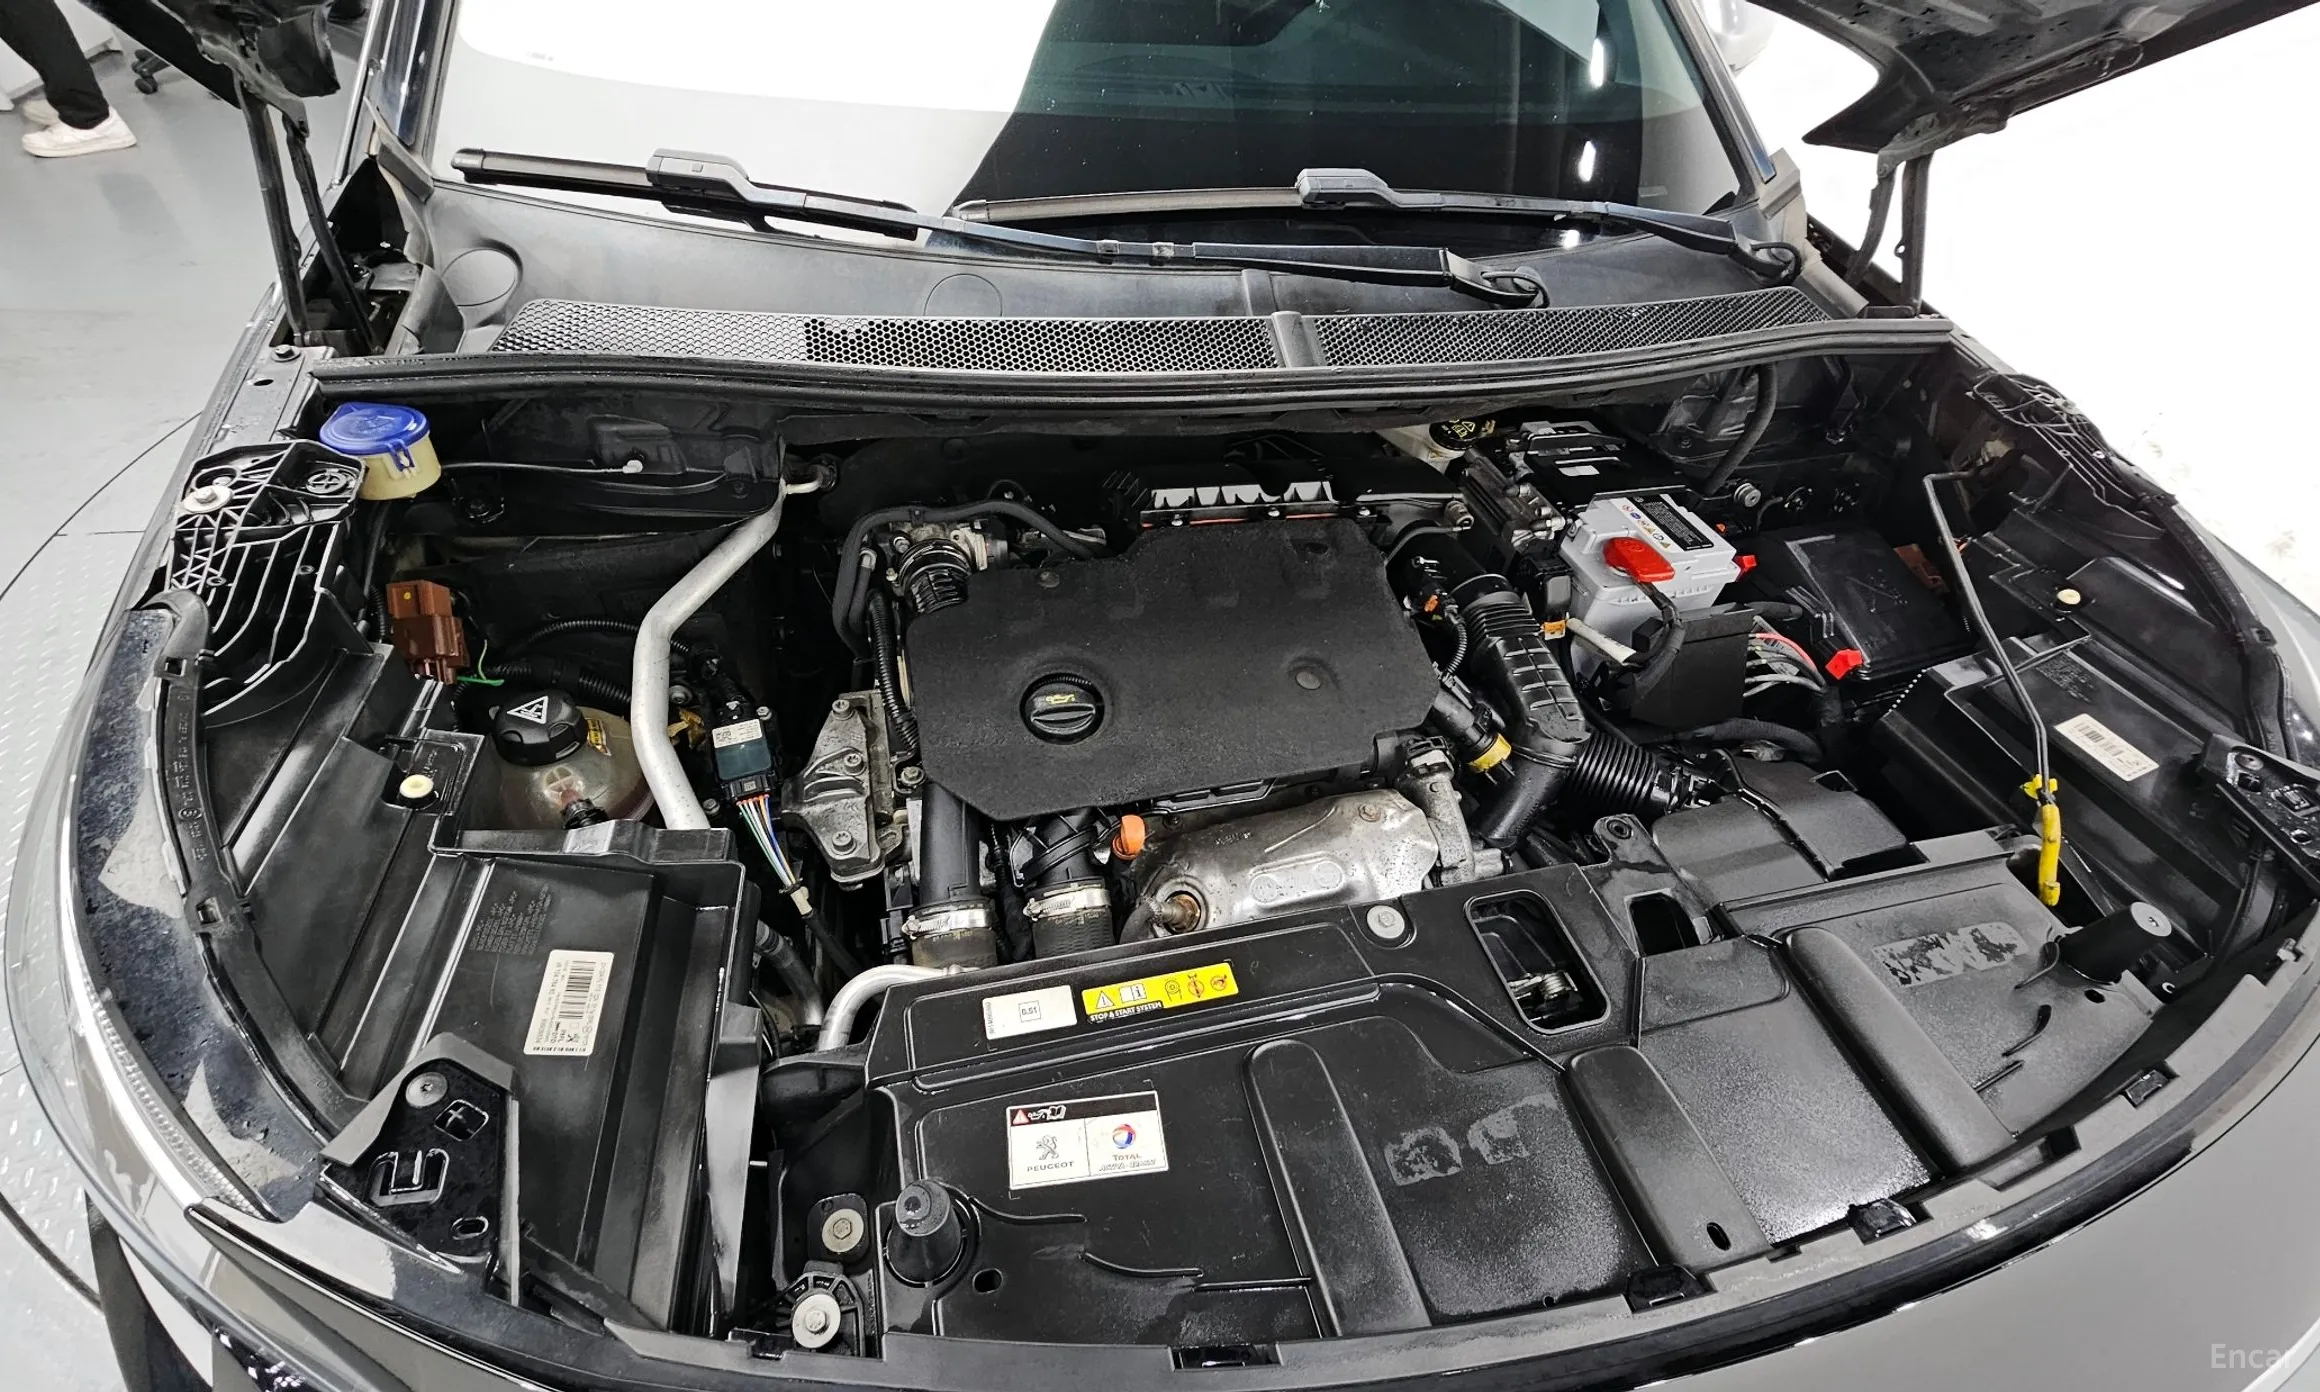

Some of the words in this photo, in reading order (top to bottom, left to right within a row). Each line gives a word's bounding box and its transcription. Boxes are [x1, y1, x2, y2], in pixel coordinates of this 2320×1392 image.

[1090, 1013, 1108, 1022] STOP
[1114, 1006, 1135, 1017] START
[1135, 1001, 1162, 1012] SYSTEM
[1112, 1153, 1142, 1162] TOTAL
[1026, 1161, 1075, 1172] PEUGEOT
